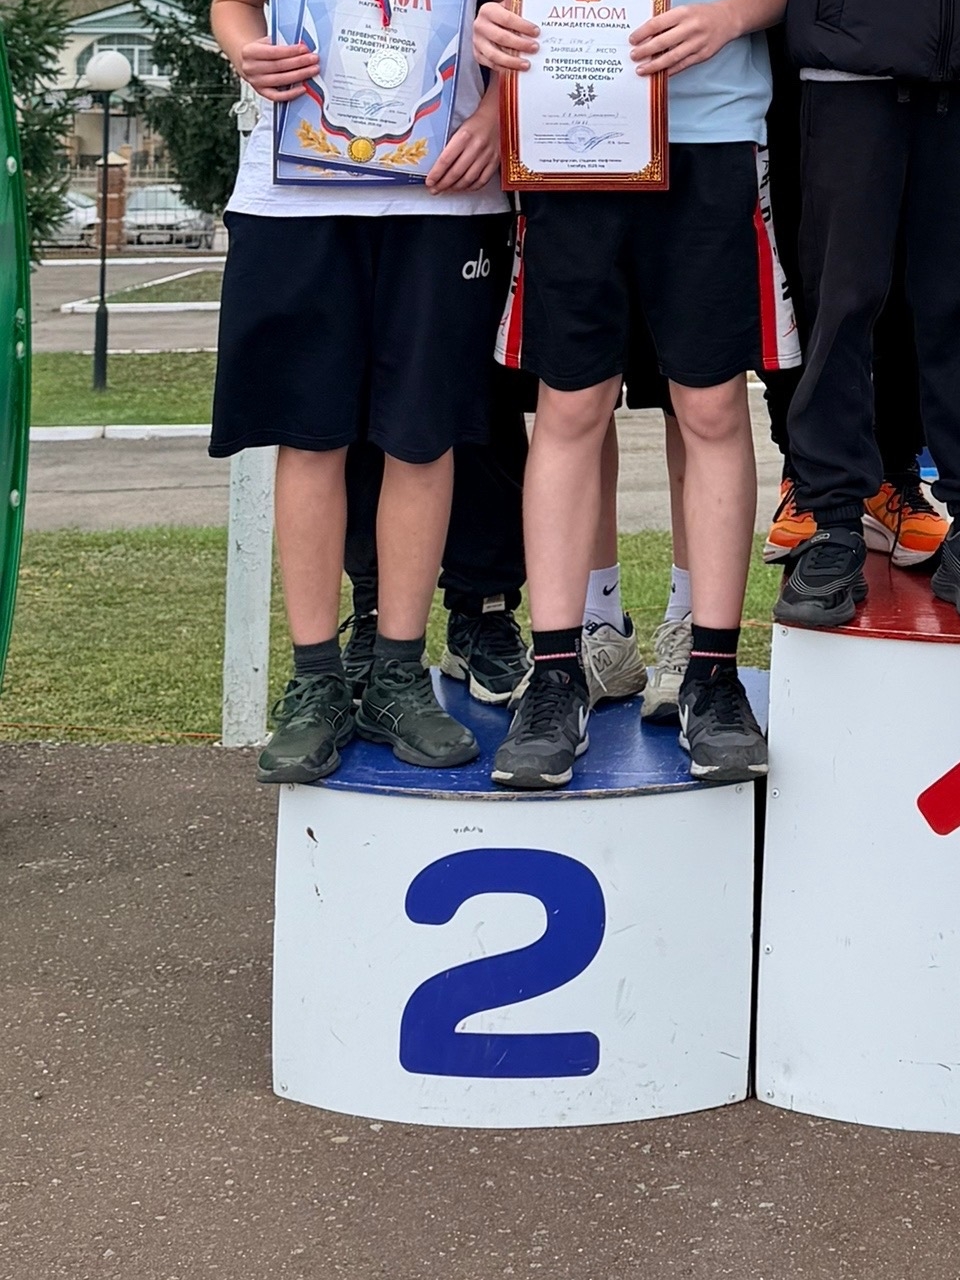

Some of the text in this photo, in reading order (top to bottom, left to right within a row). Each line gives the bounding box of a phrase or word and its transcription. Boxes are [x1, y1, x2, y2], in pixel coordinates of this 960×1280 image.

[547, 7, 626, 20] ДИПЛОМ
[338, 36, 350, 44] ПО
[401, 45, 417, 54] БЕГУ
[346, 45, 376, 54] «ЗОЛОТА
[389, 37, 416, 47] ГОРОДА
[462, 249, 490, 279] alo
[400, 847, 605, 1079] 2
